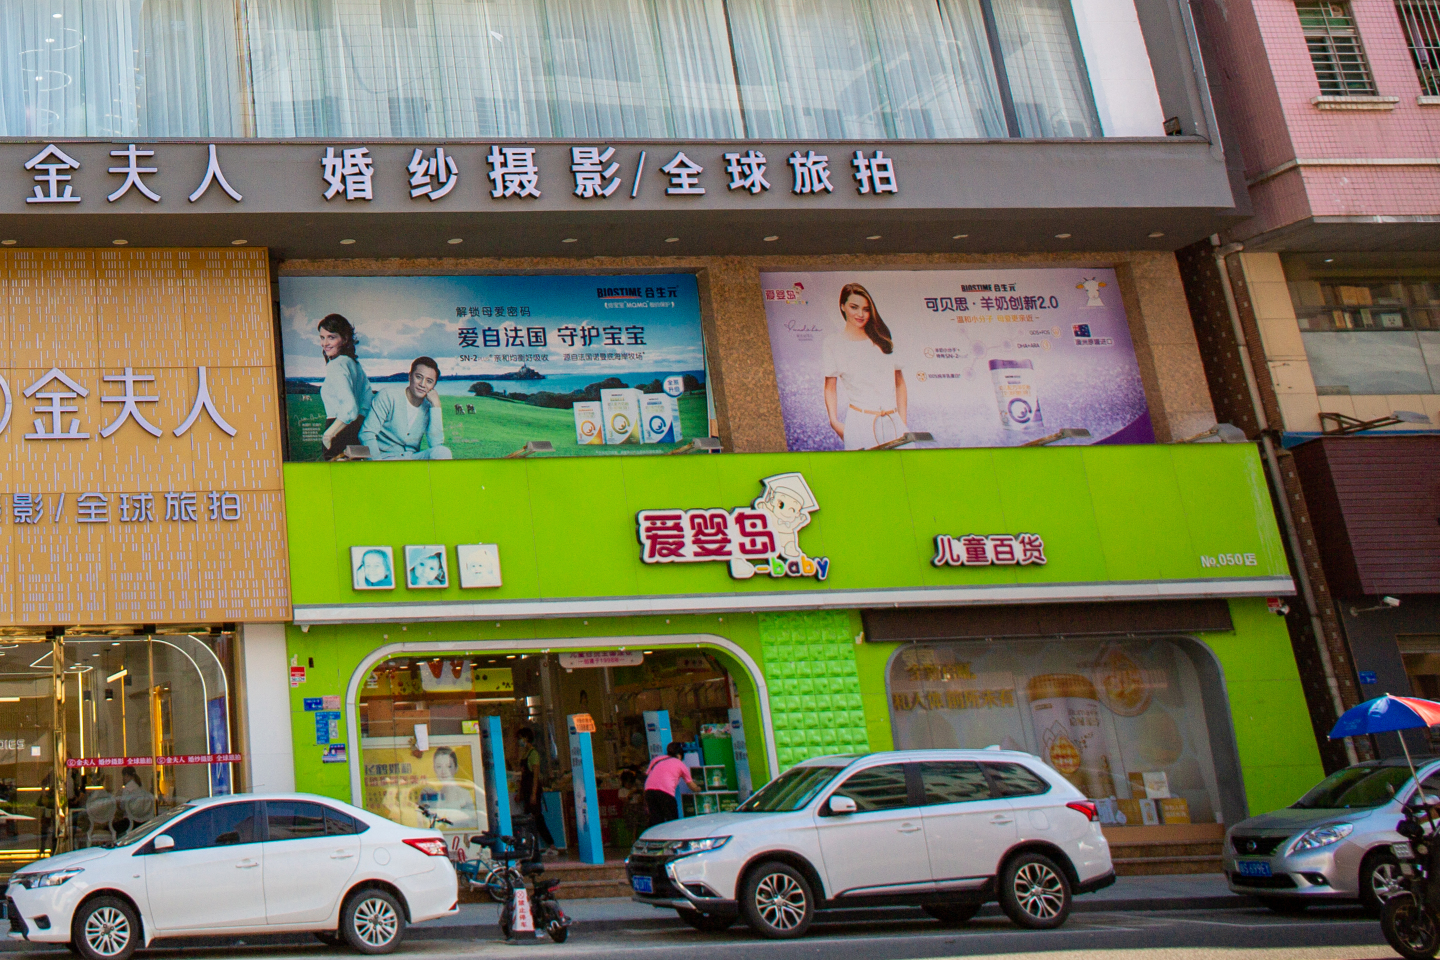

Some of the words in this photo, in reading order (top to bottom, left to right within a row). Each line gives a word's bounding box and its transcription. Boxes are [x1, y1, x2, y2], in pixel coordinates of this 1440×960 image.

[24, 143, 244, 204] 金夫人
[320, 145, 901, 202] 婚纱摄影/全球旅拍
[455, 305, 531, 318] 解锁母爱密码
[596, 287, 643, 299] BIOSTIME
[644, 286, 679, 299] 合生元
[457, 326, 548, 349] 爱自法国
[556, 324, 648, 347] 守护宝宝
[22, 366, 237, 440] 金夫人
[643, 511, 777, 558] 爱婴岛
[935, 534, 1046, 566] 儿童百货
